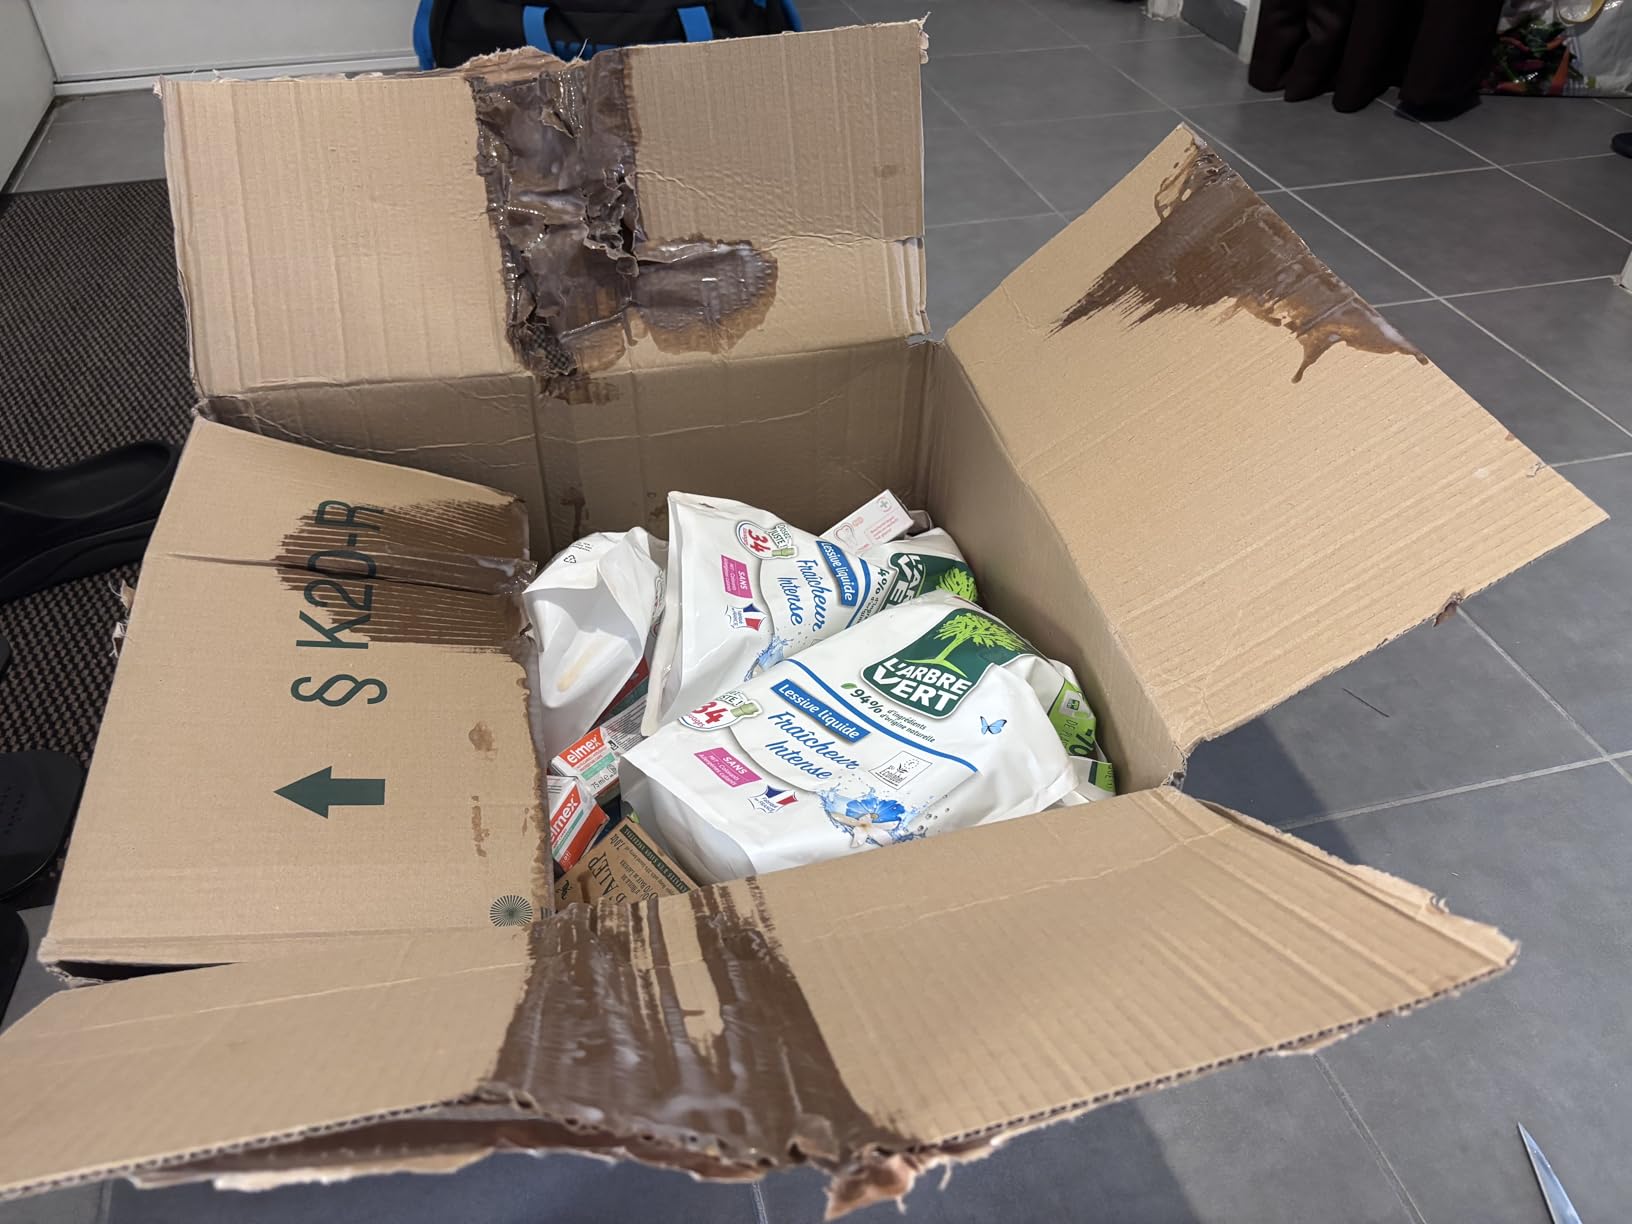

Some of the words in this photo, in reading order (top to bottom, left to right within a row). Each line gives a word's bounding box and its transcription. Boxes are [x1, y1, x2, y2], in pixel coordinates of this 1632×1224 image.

[748, 529, 771, 552] 34
[738, 570, 748, 590] SANS
[820, 541, 842, 568] Lessive
[835, 565, 854, 601] liquide
[875, 568, 890, 595] 4%
[890, 554, 911, 603] VE
[777, 577, 803, 627] Intense
[796, 559, 832, 633] Fraîcheur
[874, 665, 963, 712] VERT
[882, 657, 973, 694] L'ARBRE
[692, 701, 729, 725] 34
[778, 684, 818, 714] Lessive
[816, 706, 861, 741] liquide
[850, 688, 884, 714] 94%
[887, 709, 927, 731] d'ingrédients
[880, 713, 907, 730] d'origine
[906, 727, 936, 743] naturelle
[566, 736, 602, 764] elmex
[765, 739, 833, 780] Intense
[768, 711, 861, 770] Fraîcheur
[723, 756, 748, 775] SANS
